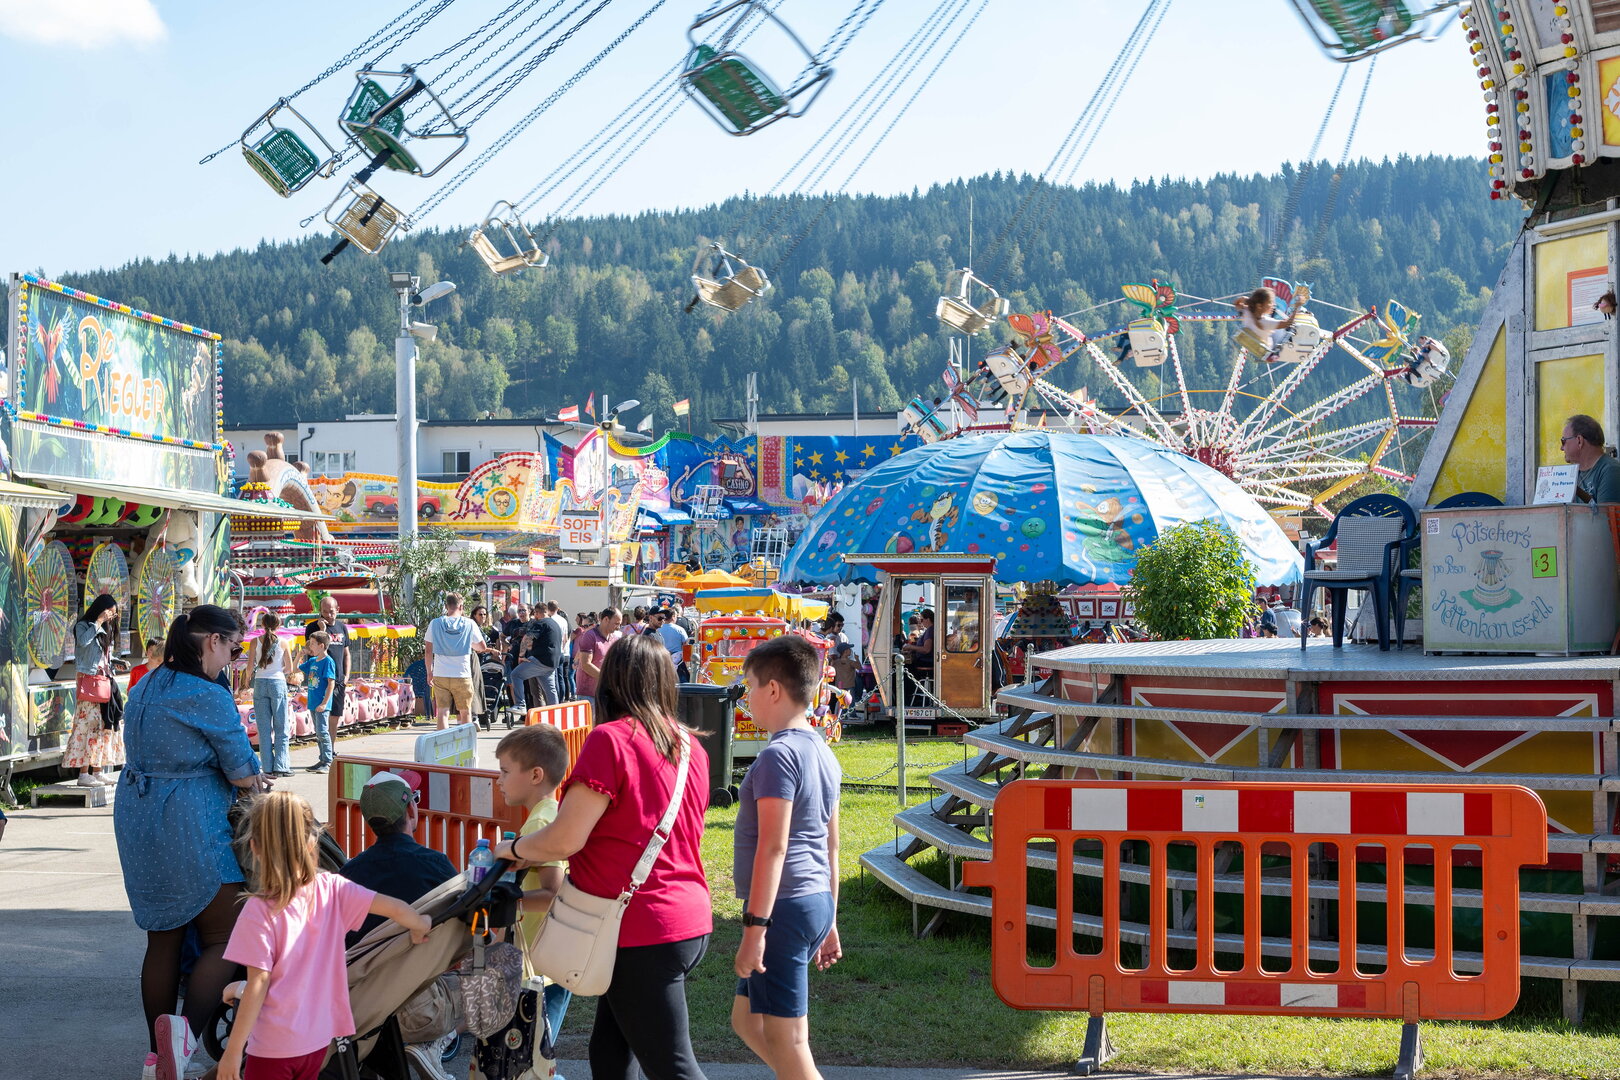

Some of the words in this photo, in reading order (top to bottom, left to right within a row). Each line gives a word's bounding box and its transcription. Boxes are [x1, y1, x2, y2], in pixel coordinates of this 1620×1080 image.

[726, 478, 749, 489] CASINO
[563, 518, 600, 531] SOFT
[570, 531, 592, 543] EIS
[1432, 589, 1554, 640] Kettenkarussell
